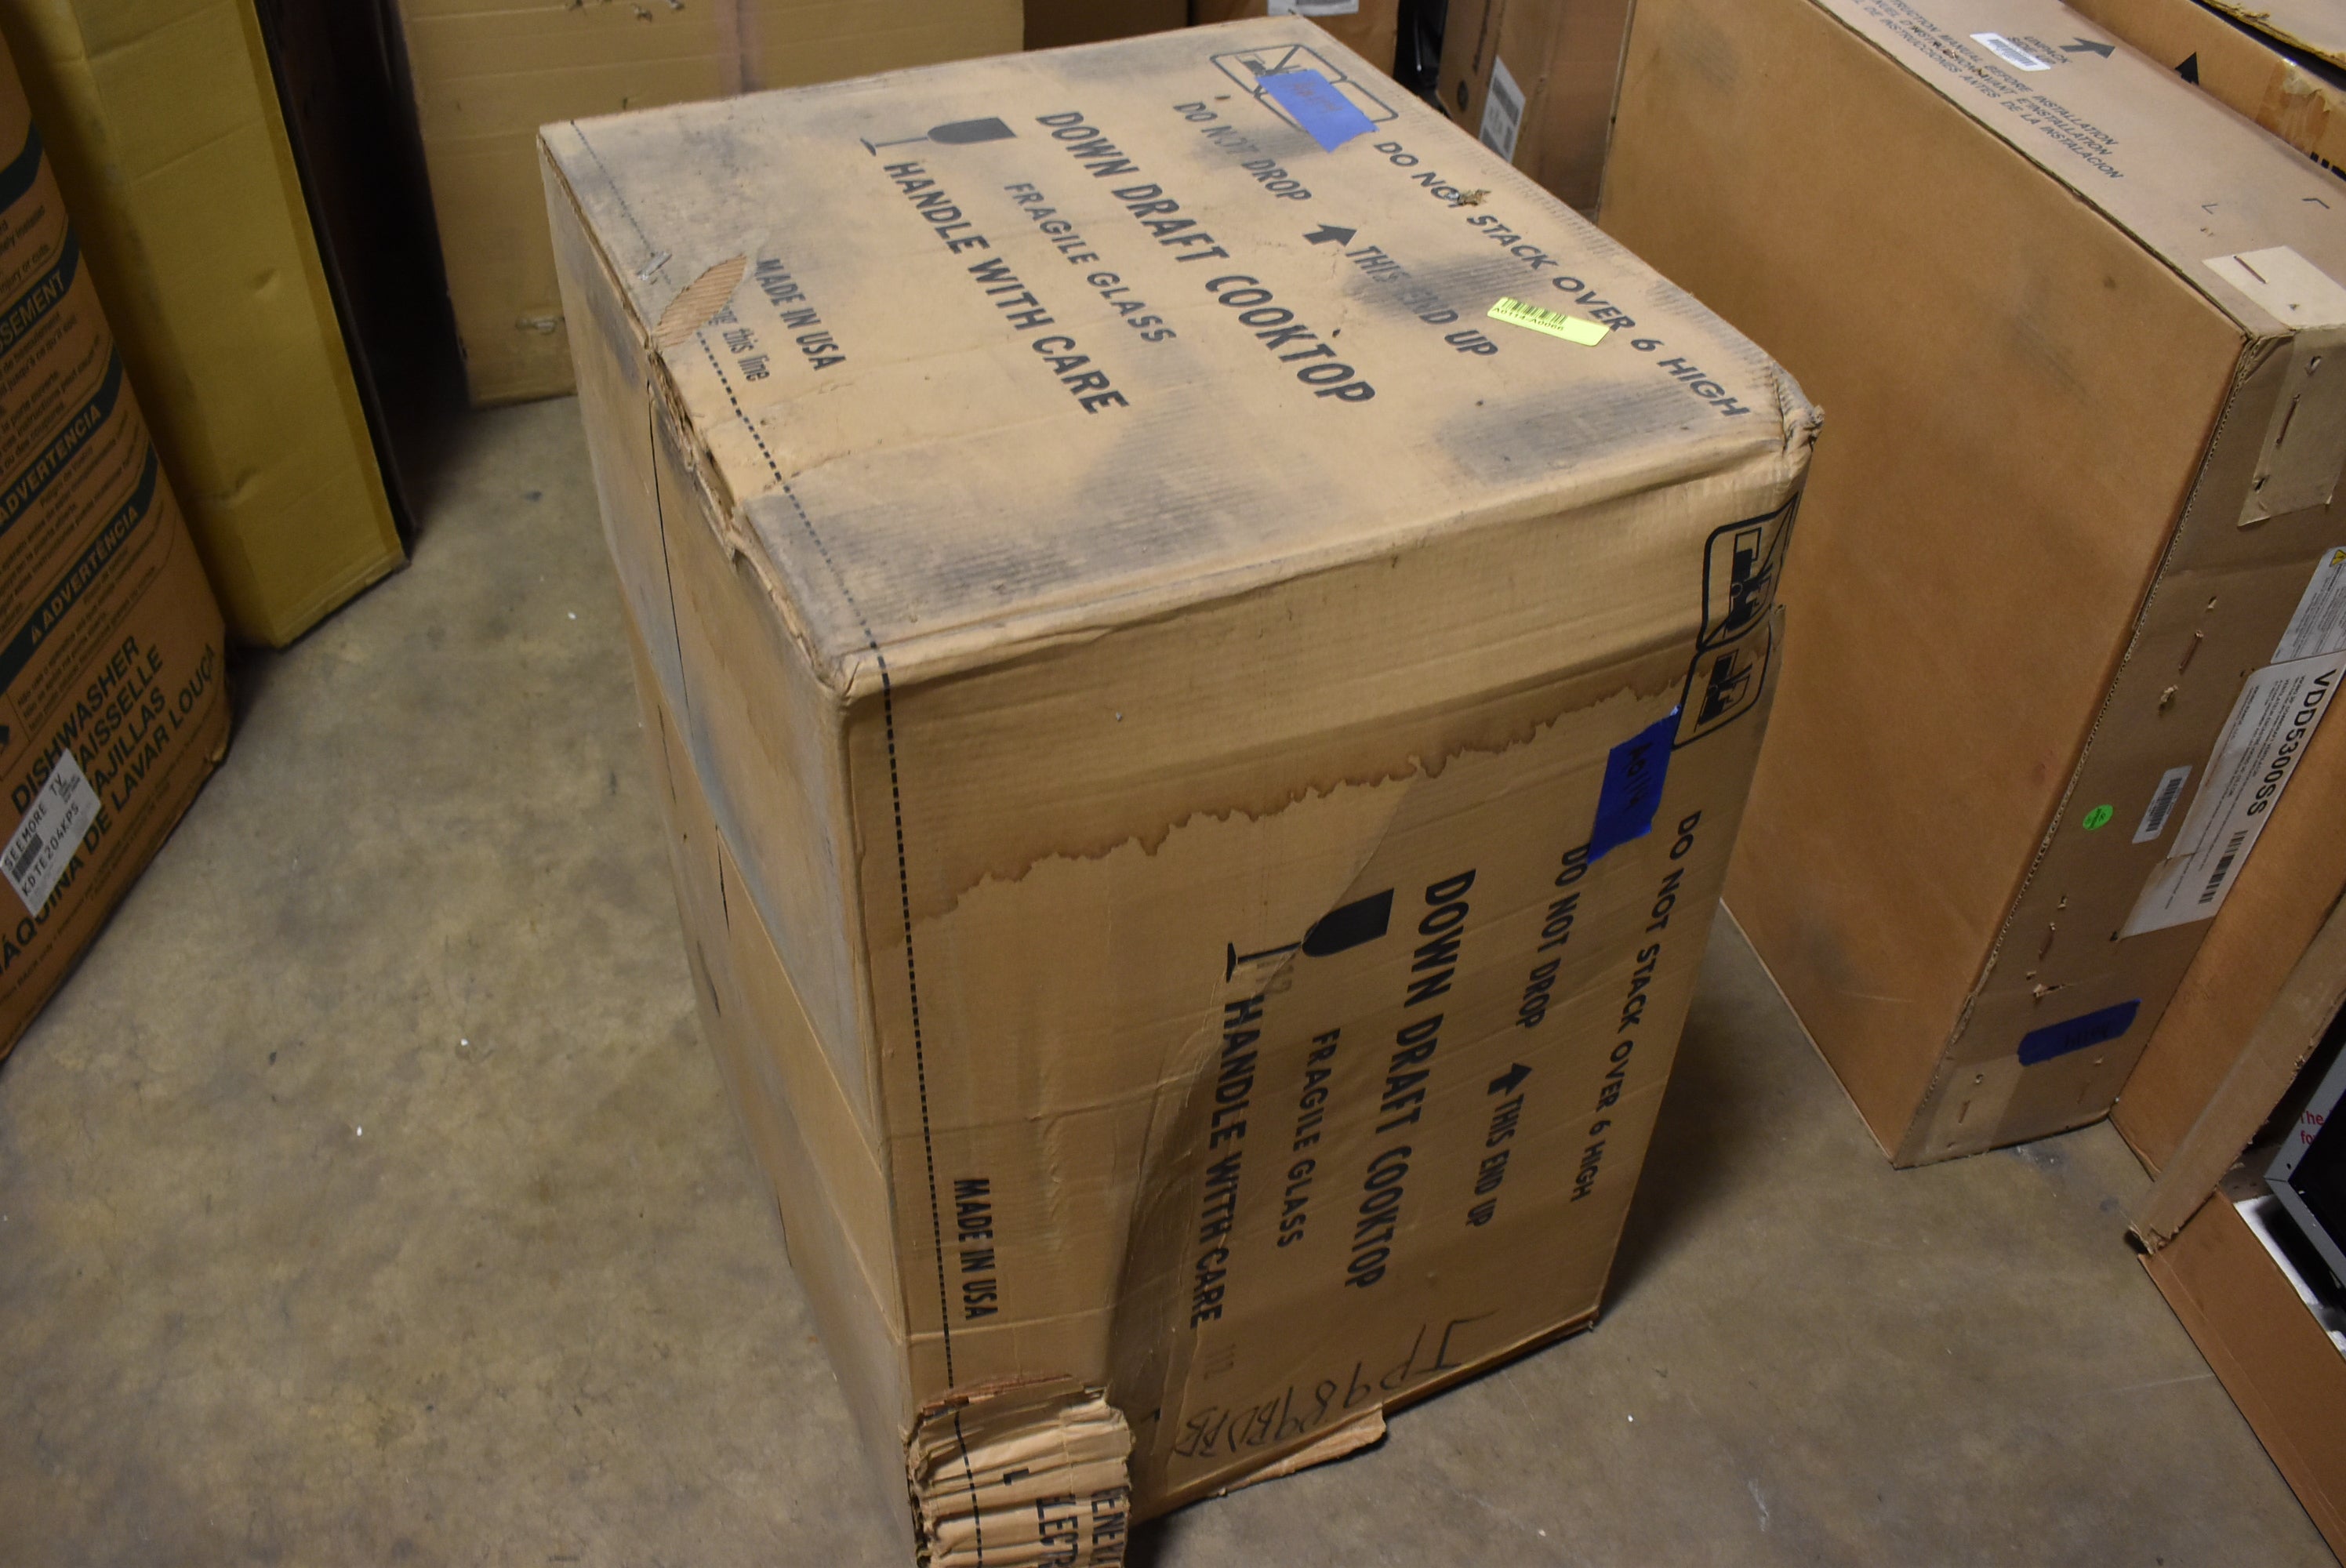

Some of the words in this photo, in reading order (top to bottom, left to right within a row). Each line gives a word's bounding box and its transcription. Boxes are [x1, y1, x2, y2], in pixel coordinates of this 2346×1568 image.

[1174, 102, 1217, 122] DO
[1241, 158, 1312, 201] DROP
[755, 258, 805, 307] MADE
[883, 162, 990, 254] HANDLE
[968, 257, 1055, 331] WITH
[1032, 336, 1129, 414] CARE
[1004, 183, 1099, 265] FRAGILE
[1087, 270, 1176, 342] GLASS
[1036, 112, 1138, 178] DOWN
[1112, 183, 1229, 262] DRAFT
[1205, 275, 1375, 402] COOKTOP
[1374, 141, 1418, 167] DO
[1466, 214, 1557, 270] STACK
[1552, 276, 1636, 332] OVER
[1631, 338, 1661, 352] 6
[1658, 358, 1752, 416] HIGH
[788, 304, 820, 330] IN
[796, 330, 846, 371] USA
[1444, 329, 1498, 357] UP
[11, 635, 140, 815] DISHWASHER
[75, 644, 163, 774] AISSELLE
[89, 687, 165, 797] AJILLAS
[2246, 669, 2337, 816] VDD5300SS
[83, 805, 113, 854] DE
[111, 724, 170, 812] LAVAR
[1669, 811, 1701, 861] DO
[1404, 868, 1477, 1009] DOWN
[1536, 892, 1580, 954] NOT
[1647, 868, 1685, 933] NOT
[1515, 956, 1562, 1029] DROP
[1616, 942, 1661, 1034] STACK
[1208, 993, 1266, 1152] HANDLE
[1292, 1027, 1342, 1152] FRAGILE
[1375, 1013, 1444, 1134] DRAFT
[1595, 1040, 1635, 1113] OVER
[1490, 1094, 1524, 1147] THIS
[1589, 1120, 1612, 1135] 6
[954, 1178, 993, 1243] MADE
[1198, 1152, 1243, 1246] WITH
[1276, 1159, 1316, 1249] GLASS
[1344, 1145, 1412, 1289] COOKTOP
[1570, 1140, 1605, 1203] HIGH
[959, 1244, 995, 1273] IN
[961, 1276, 998, 1320] USA
[1189, 1247, 1230, 1330] CARE
